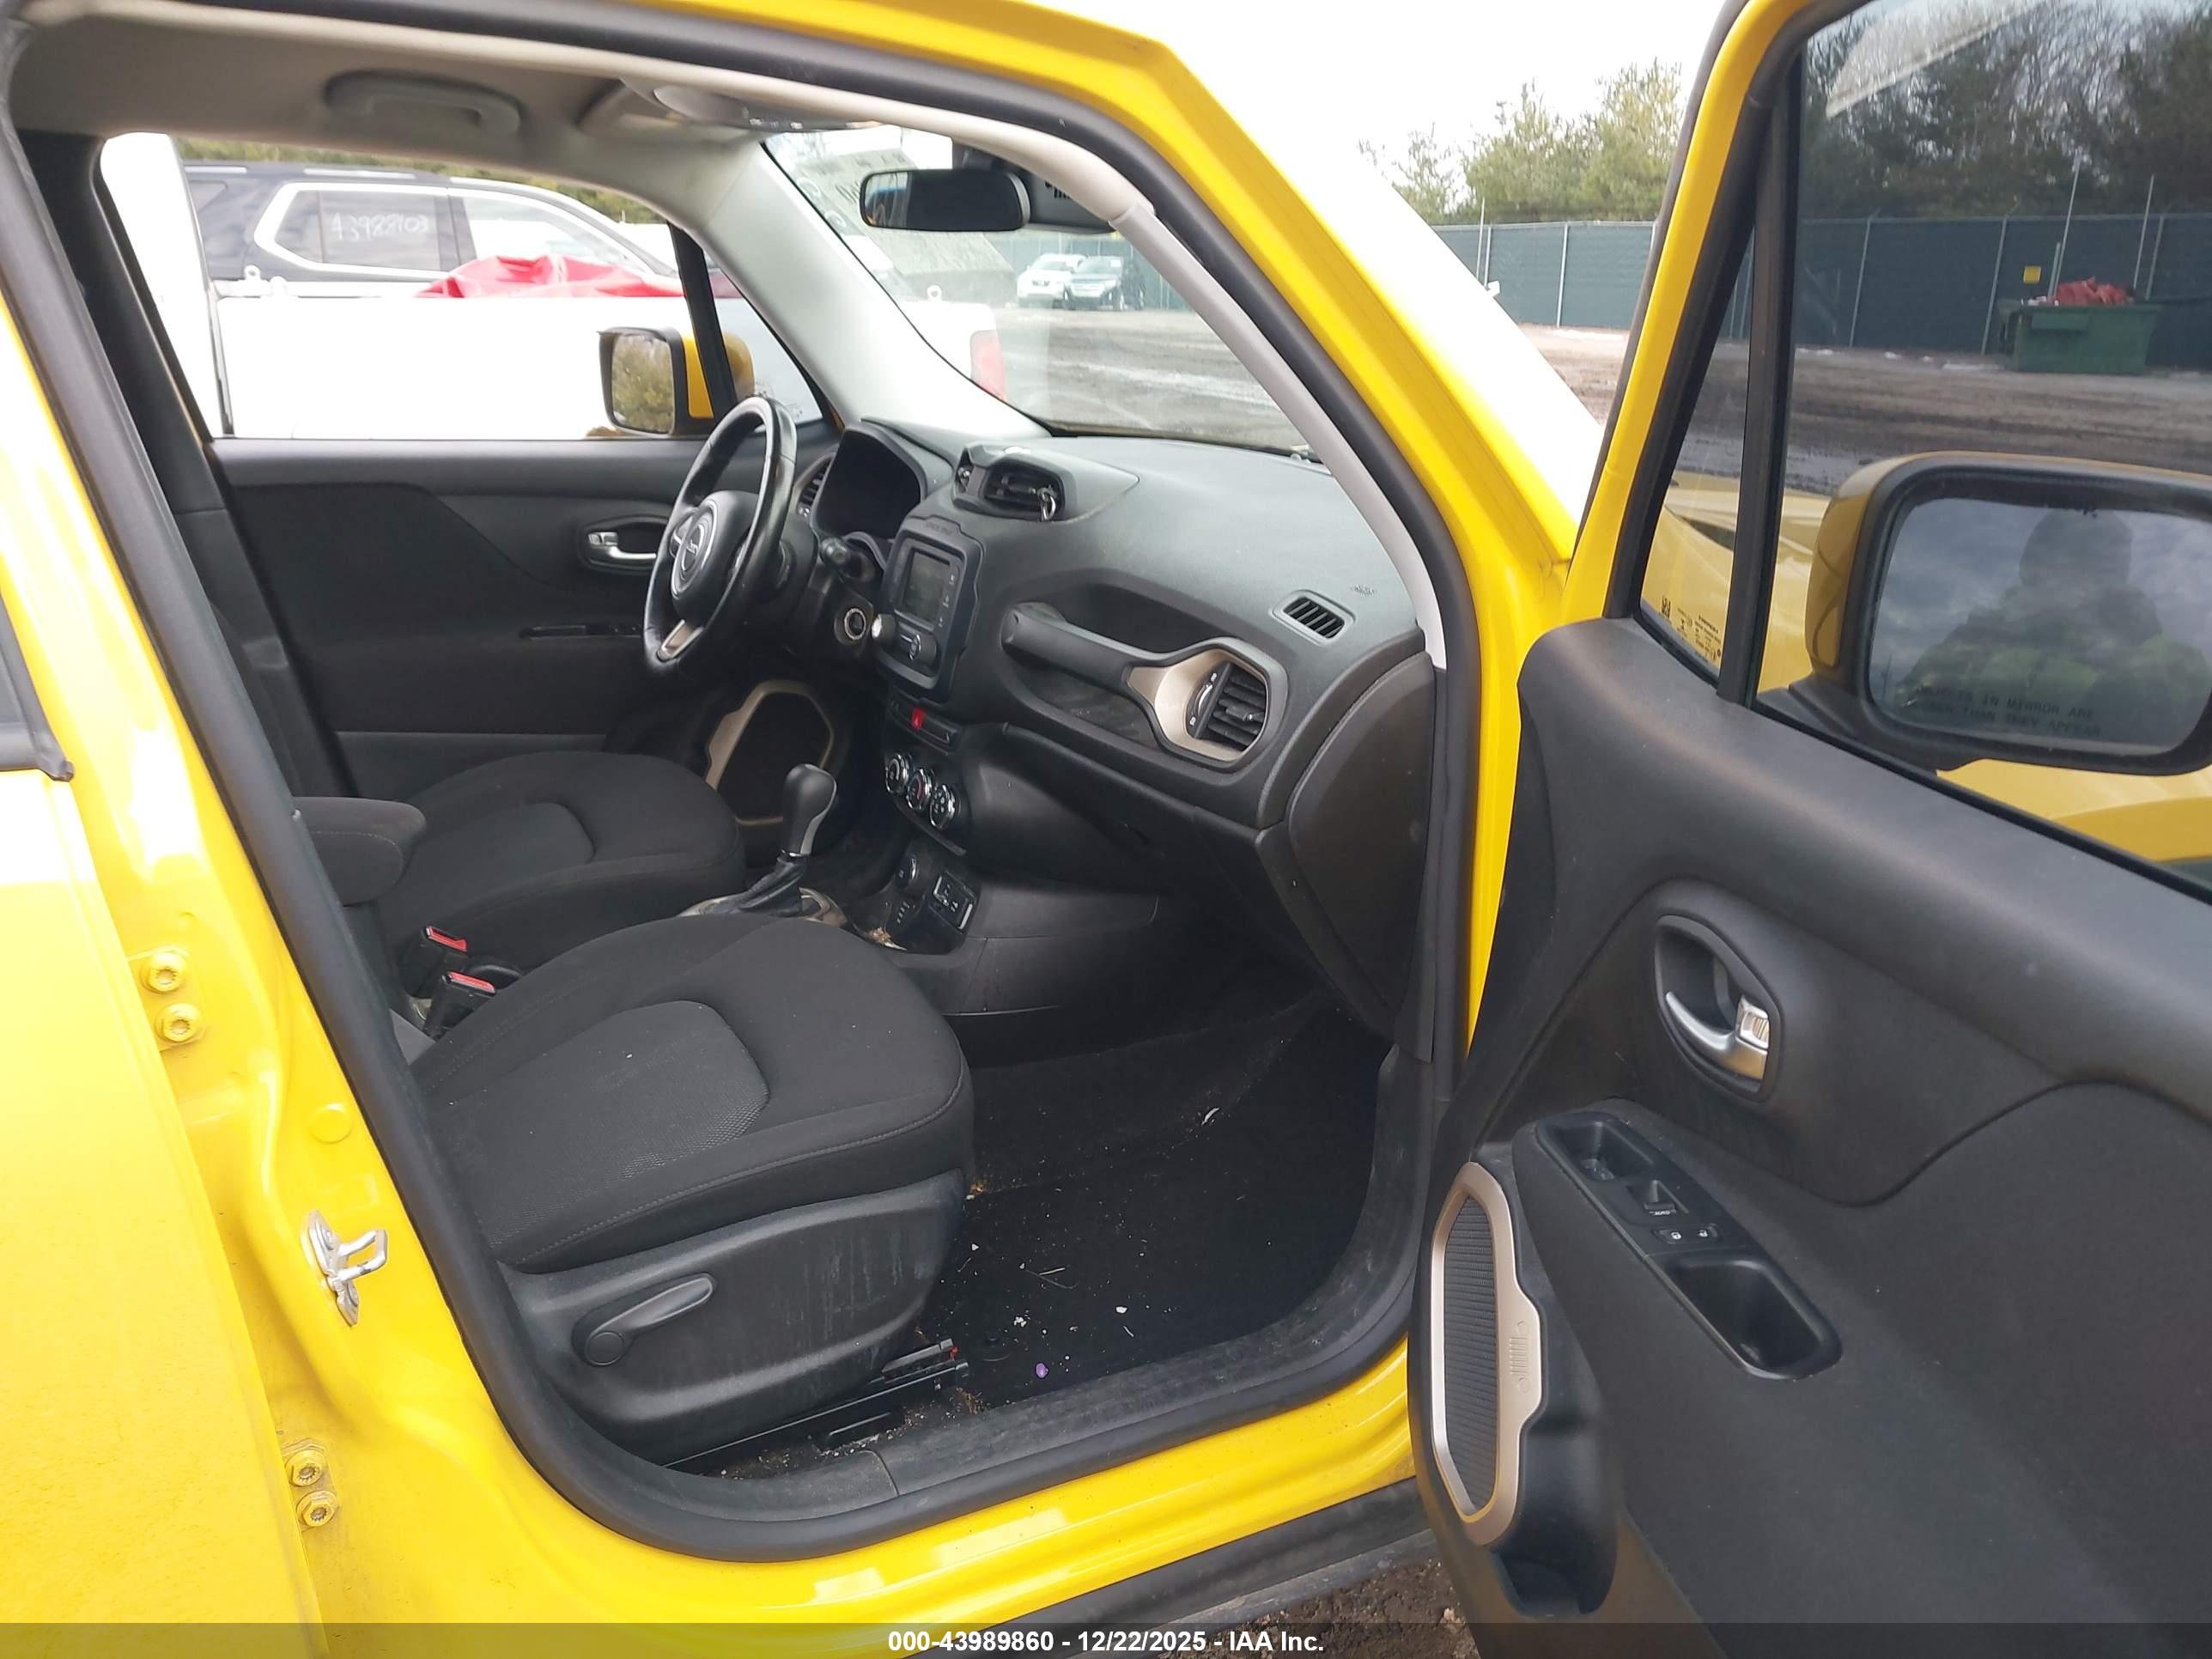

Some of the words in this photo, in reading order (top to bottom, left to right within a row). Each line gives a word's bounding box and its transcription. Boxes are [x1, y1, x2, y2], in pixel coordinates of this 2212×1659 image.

[1983, 693, 1999, 706] IN
[2006, 697, 2061, 715] MIRROR
[2067, 707, 2094, 719] ARE
